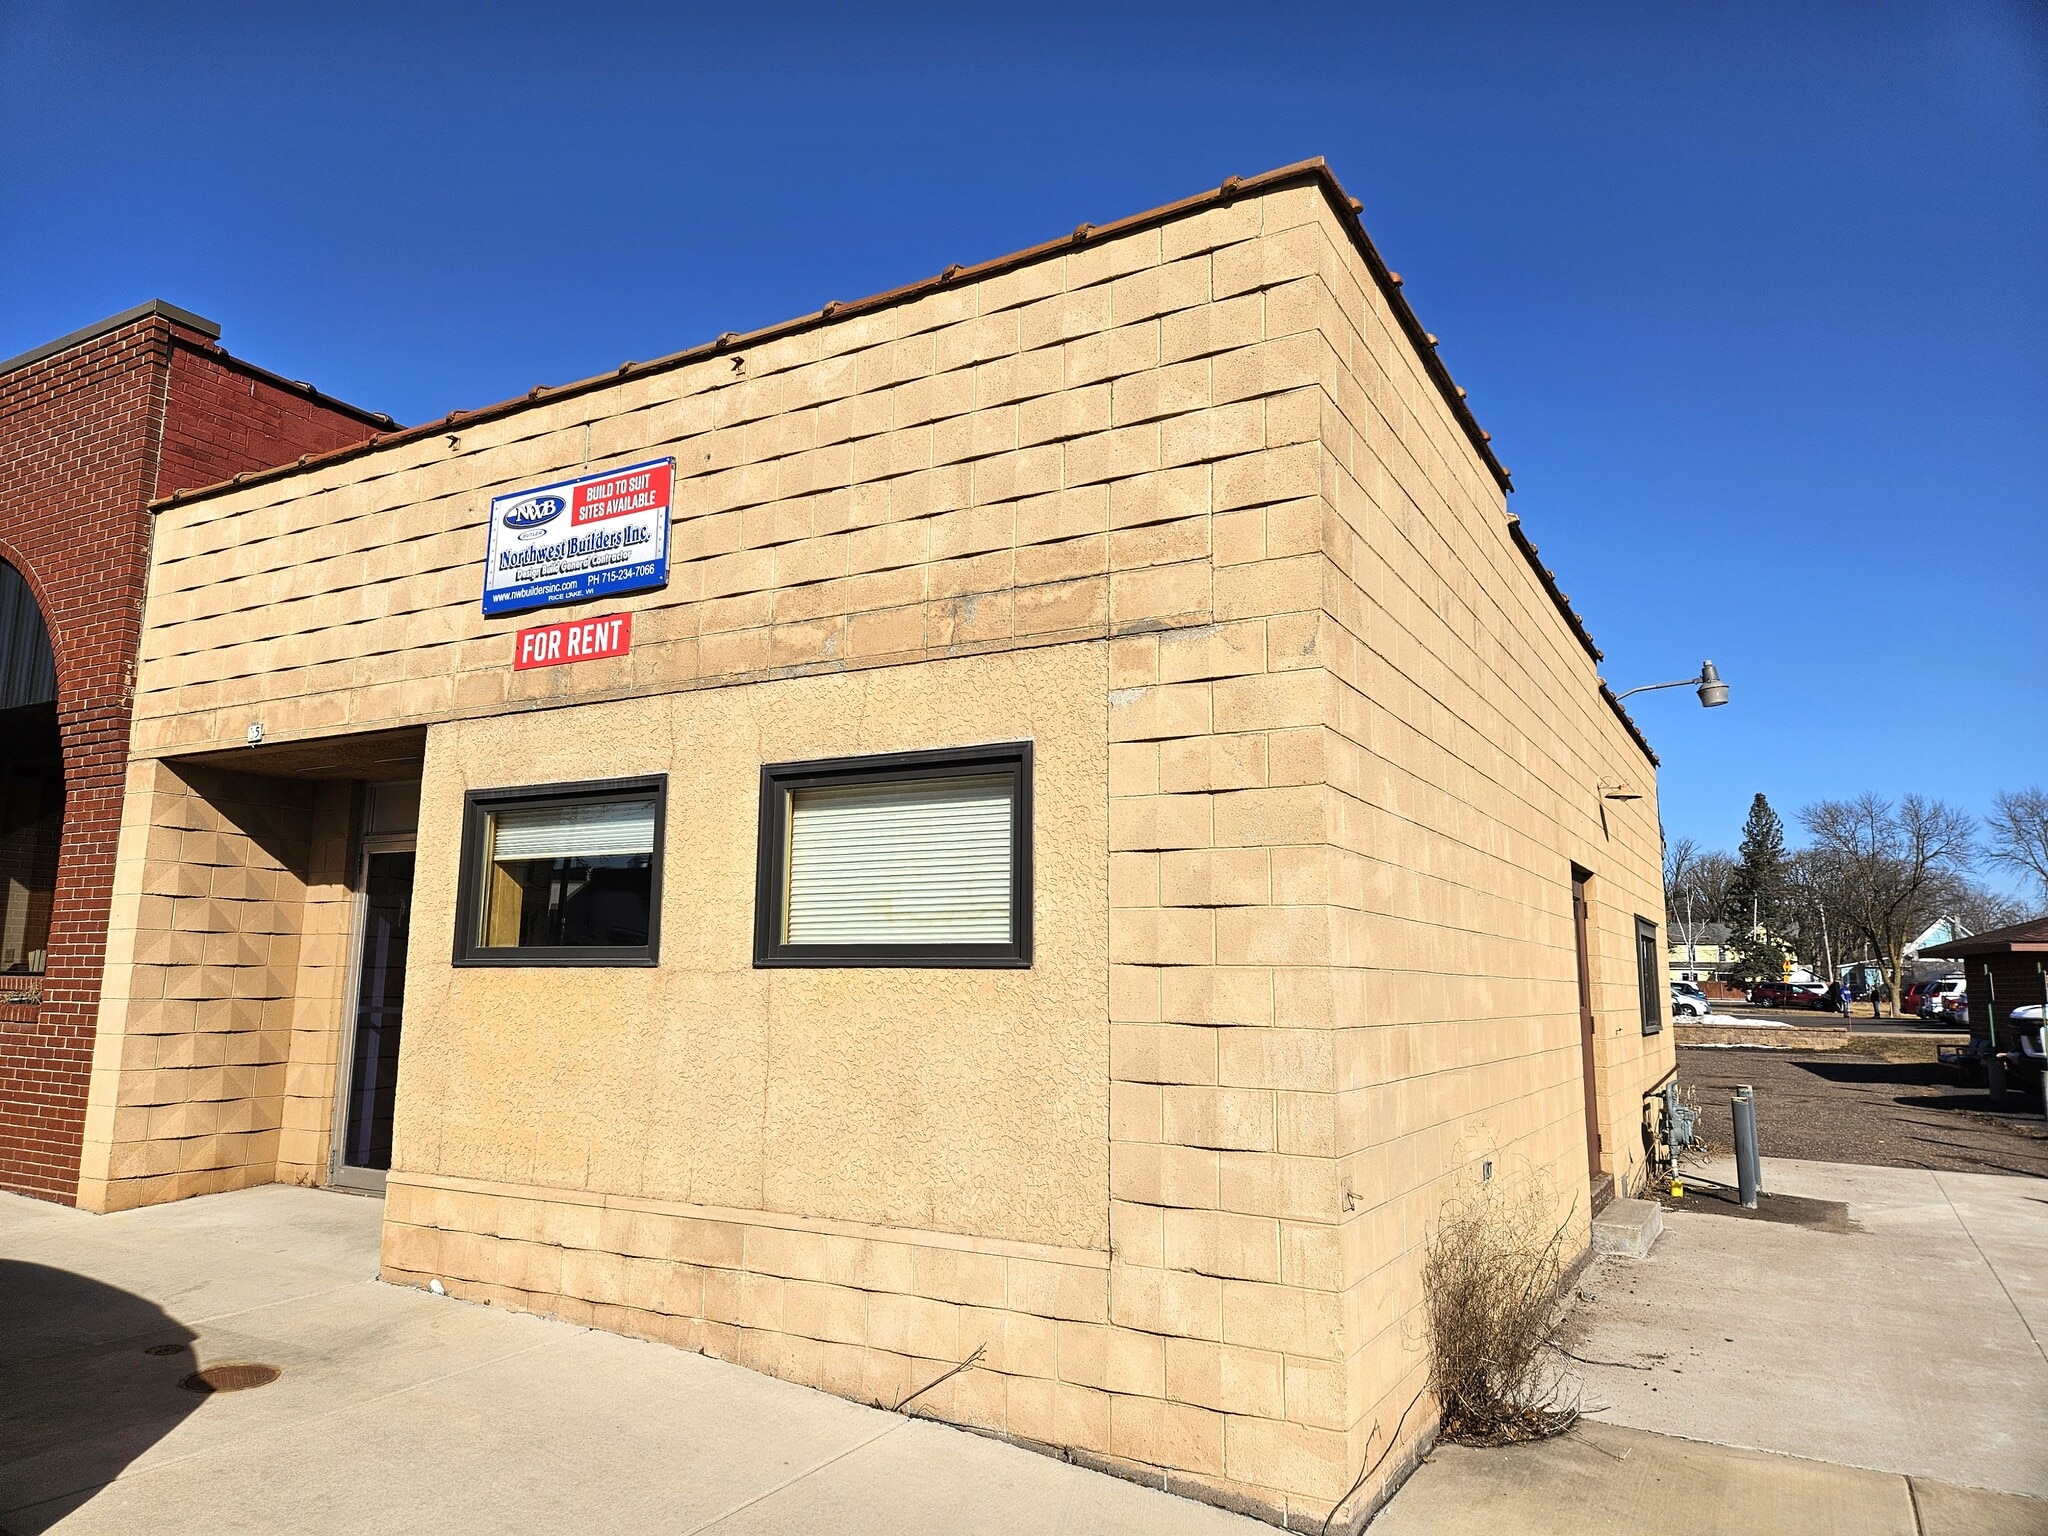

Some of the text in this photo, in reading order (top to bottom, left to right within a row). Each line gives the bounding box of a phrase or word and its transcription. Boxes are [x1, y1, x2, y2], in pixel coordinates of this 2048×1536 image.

[586, 473, 651, 502] BUILD TO SUIT
[515, 499, 556, 522] NWB
[579, 490, 656, 521] SITES AVAILABLE
[499, 525, 651, 571] Northwest Builders Inc.
[522, 530, 543, 539] BUTLER
[515, 550, 632, 582] Design Build General Contractor
[492, 563, 655, 603] www.nwbuildersinc.com PH 715-234-7066
[548, 593, 564, 601] RICE
[521, 619, 623, 664] FOR RENT
